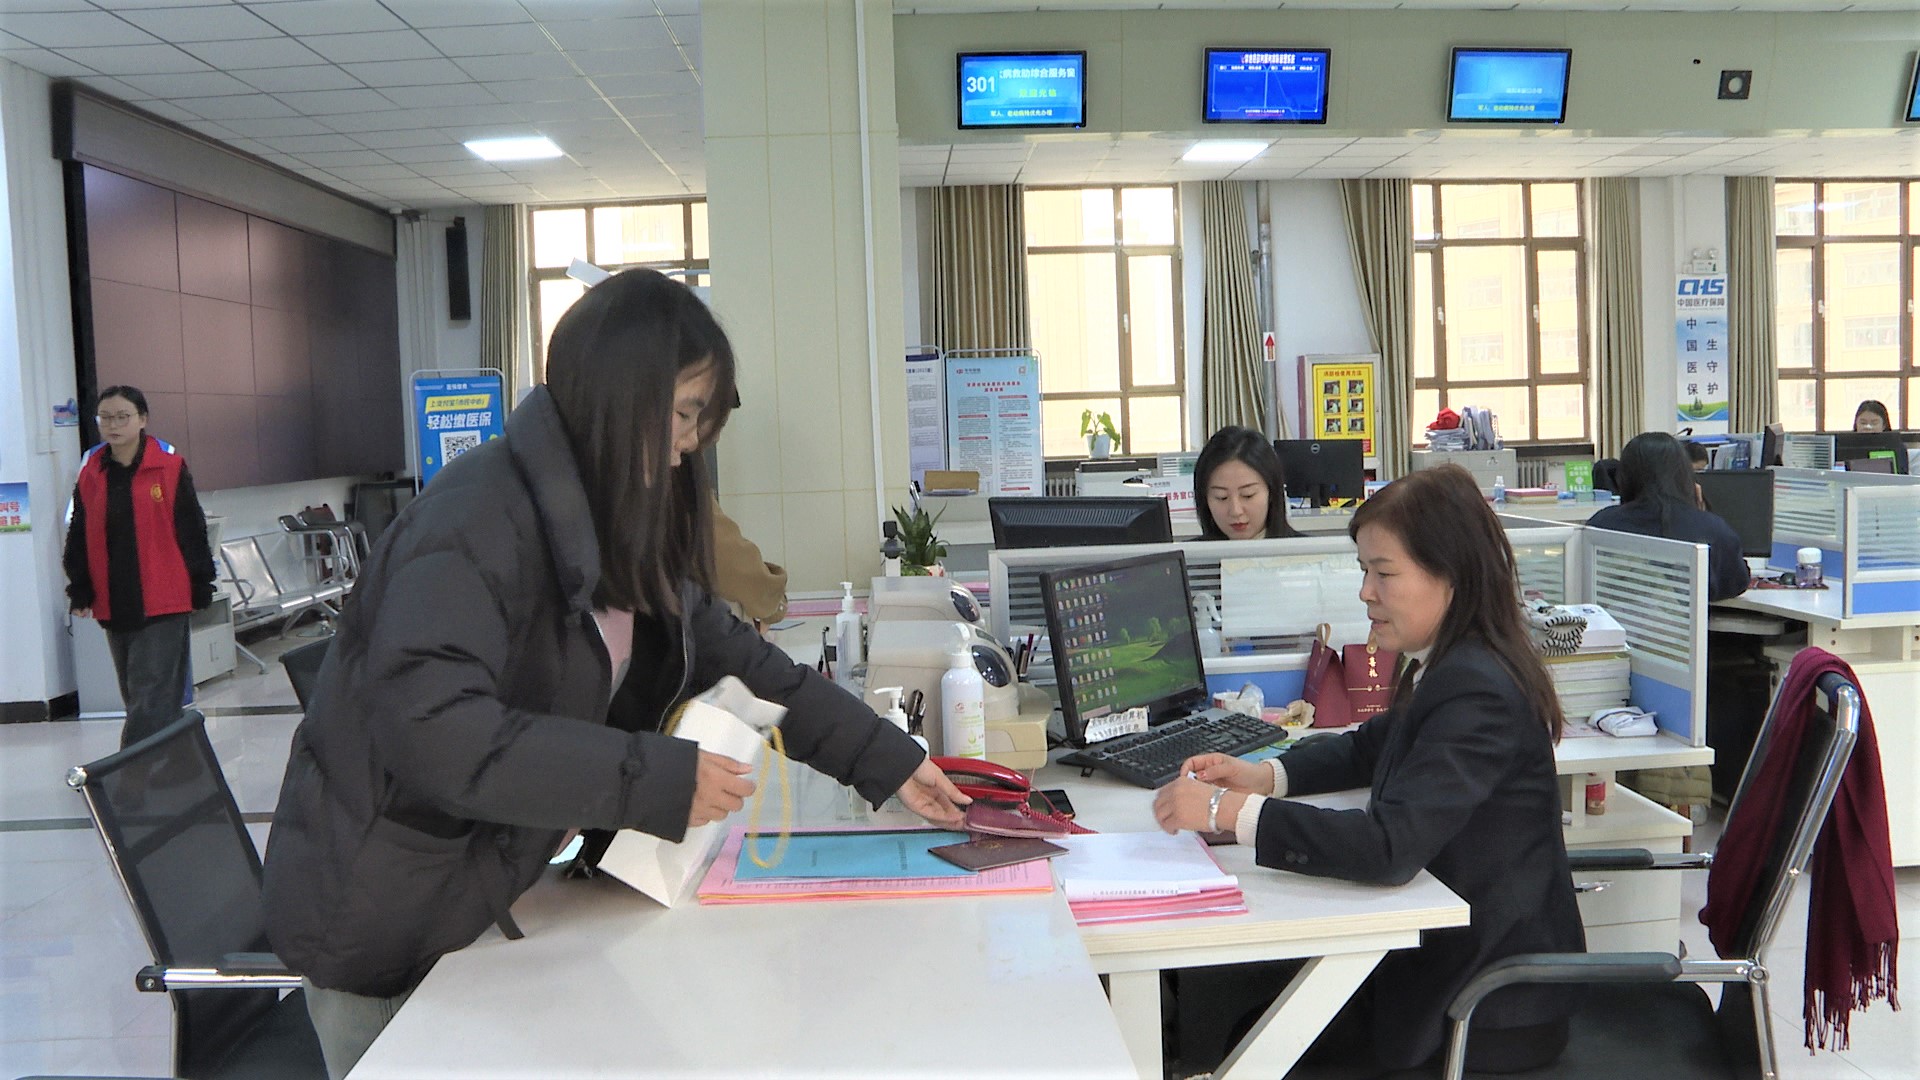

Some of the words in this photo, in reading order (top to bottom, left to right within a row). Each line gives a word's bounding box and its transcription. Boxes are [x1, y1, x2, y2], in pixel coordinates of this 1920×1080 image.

[999, 67, 1076, 79] 病救助综合服务窗
[966, 76, 996, 93] 301
[1677, 278, 1725, 296] CHS
[1676, 297, 1726, 307] 中国医疗保障
[1686, 317, 1699, 396] 中国医保
[1705, 319, 1719, 395] 一生守护
[426, 411, 493, 431] 轻松缴医保
